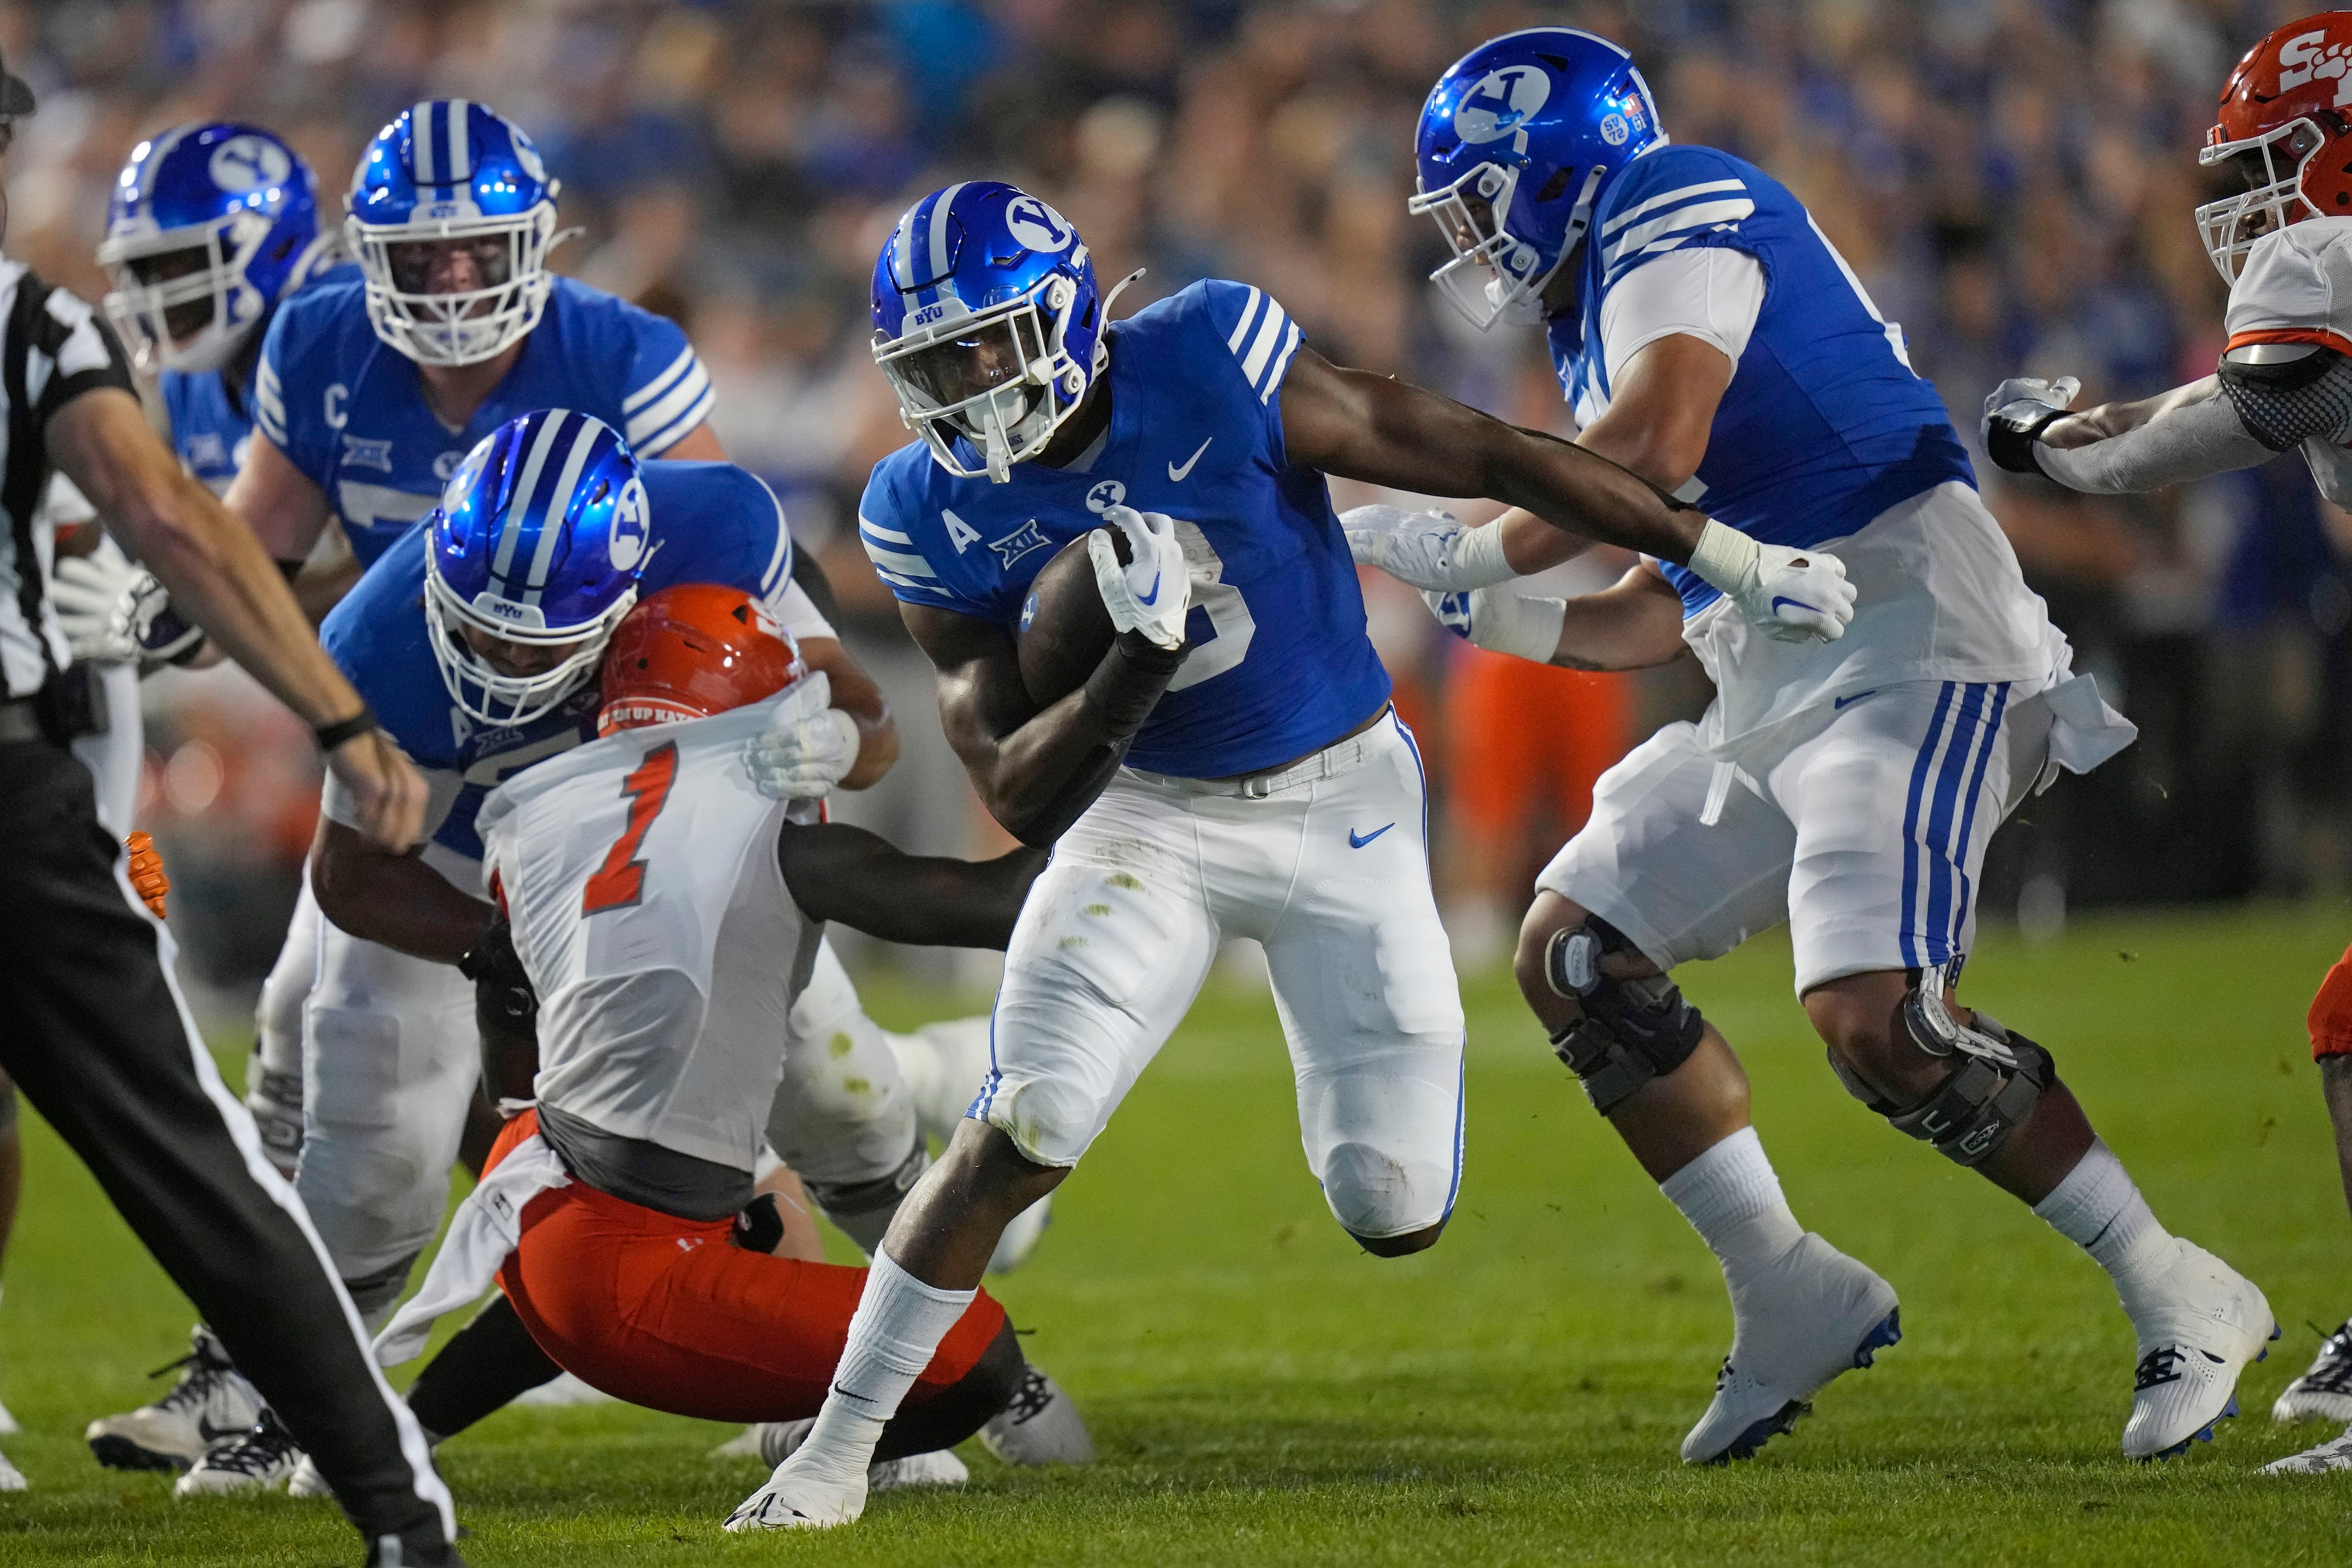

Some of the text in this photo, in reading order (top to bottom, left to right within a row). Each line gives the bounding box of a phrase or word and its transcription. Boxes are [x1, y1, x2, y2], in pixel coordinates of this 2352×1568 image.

[1462, 71, 1525, 131] Y
[1604, 117, 1619, 131] SV
[1631, 112, 1647, 132] 61
[1609, 128, 1625, 142] 72
[1013, 200, 1066, 244] Y
[915, 306, 943, 325] BYU
[324, 383, 348, 429] C
[1090, 484, 1117, 507] Y
[941, 508, 983, 555] A
[493, 603, 523, 619] BYU
[1021, 596, 1035, 625] Y
[633, 707, 653, 721] UP
[581, 739, 679, 919] 1
